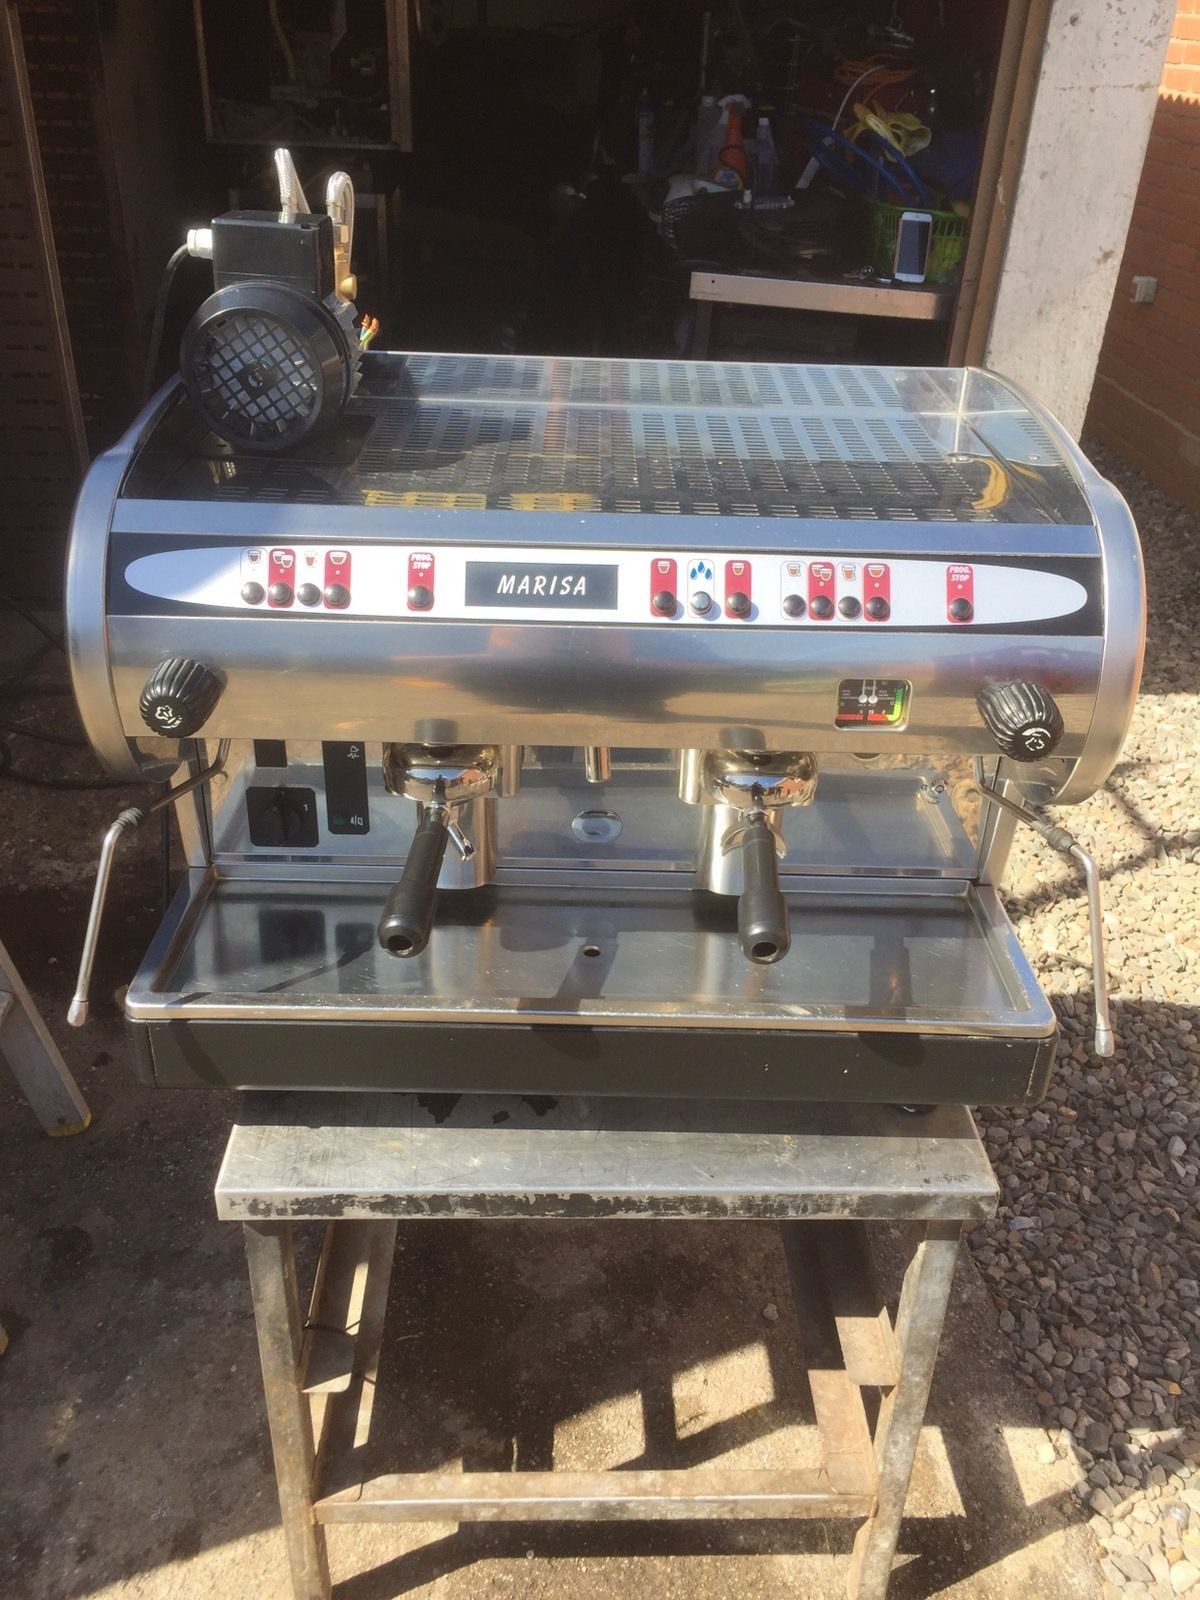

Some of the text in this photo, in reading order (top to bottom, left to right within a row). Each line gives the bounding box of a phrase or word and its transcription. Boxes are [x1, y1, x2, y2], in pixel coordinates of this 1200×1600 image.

[412, 561, 432, 569] STOP
[949, 566, 971, 574] PROG.
[951, 574, 970, 582] STOP
[496, 574, 587, 596] MARISA
